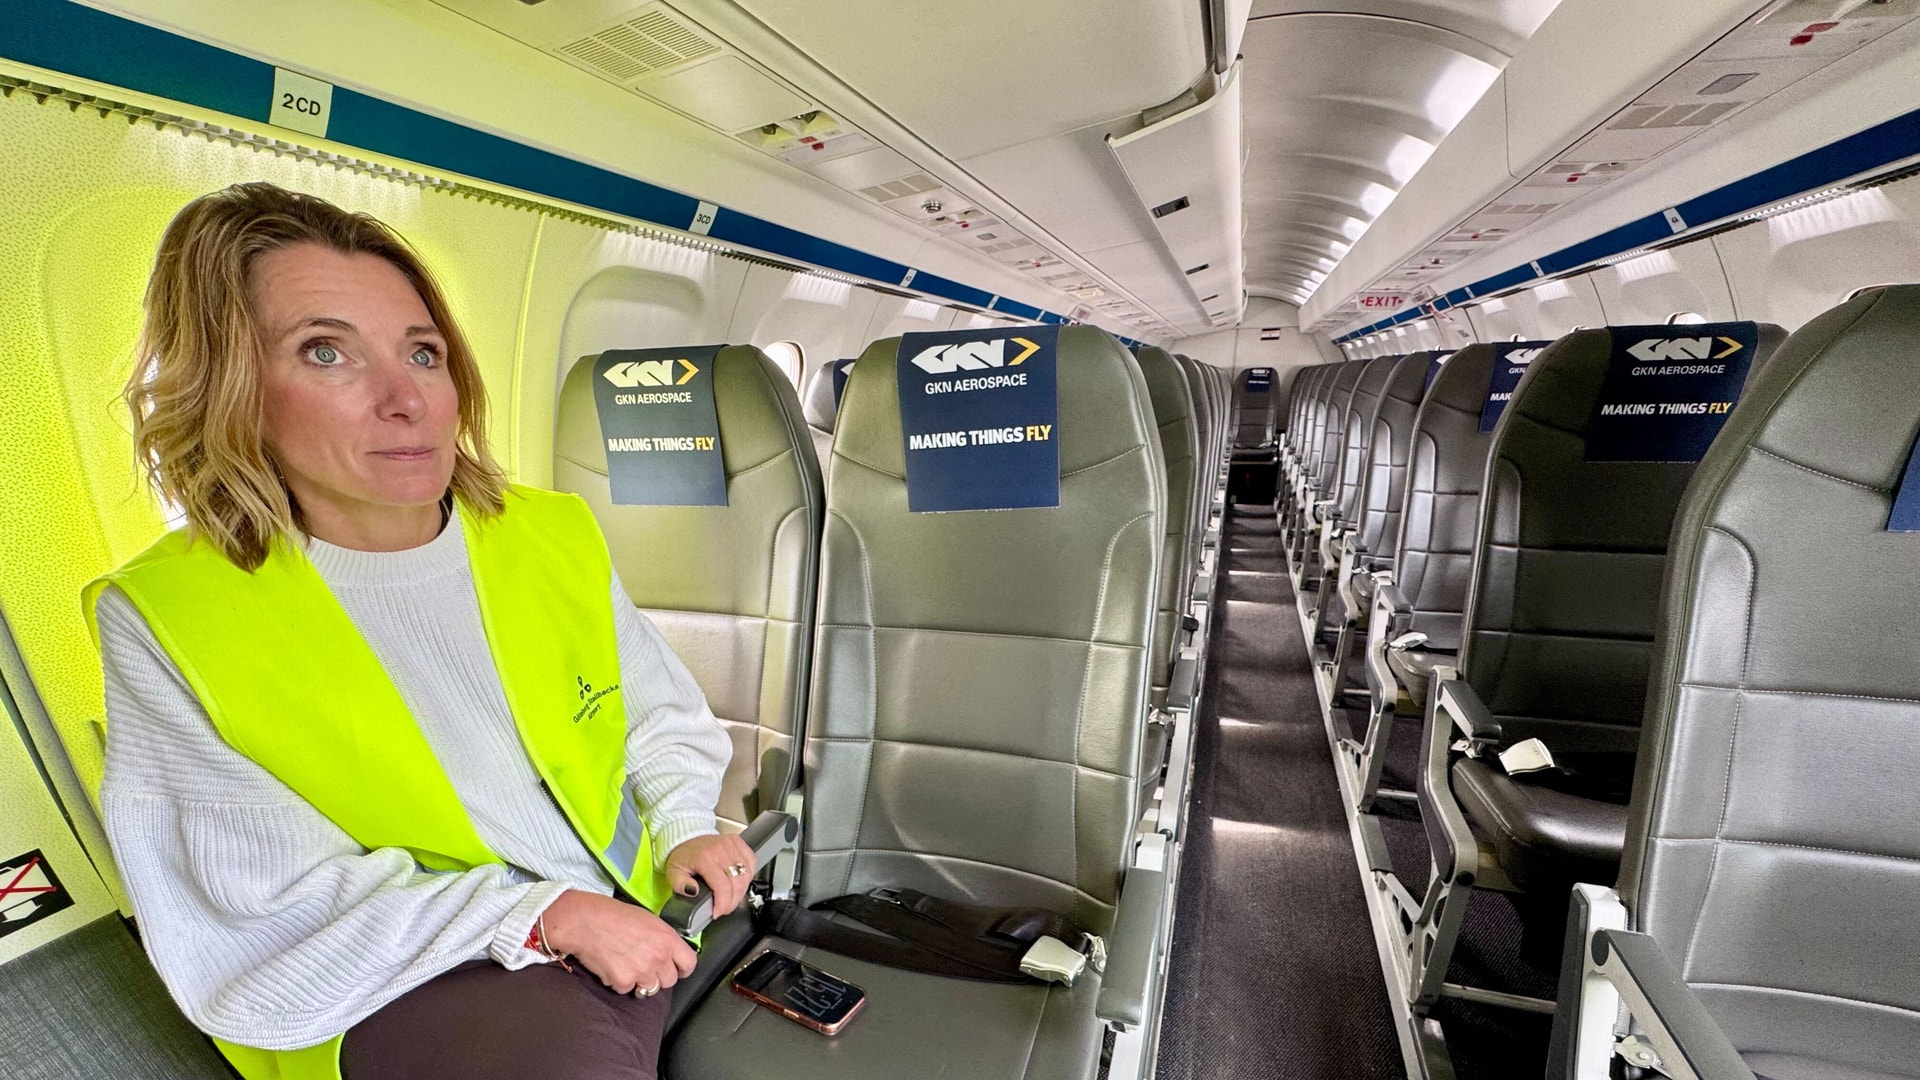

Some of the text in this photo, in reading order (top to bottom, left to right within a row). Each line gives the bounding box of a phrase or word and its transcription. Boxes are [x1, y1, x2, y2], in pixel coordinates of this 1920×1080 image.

[282, 93, 321, 116] 2CD
[696, 213, 711, 225] 3CD
[1365, 296, 1400, 307] EXIT
[1631, 365, 1725, 376] GKN AEROSPACE
[925, 373, 1028, 395] GKN AEROSPACE
[615, 392, 693, 405] GKN AEROSPACE
[1490, 392, 1512, 401] MAK
[1601, 402, 1732, 415] MAKING THINGS FLY
[608, 437, 715, 451] MAKING THINGS FLY
[909, 425, 1052, 450] MAKING THINGS FLY
[588, 684, 619, 705] Stallbacka
[588, 703, 602, 720] Airport
[784, 973, 847, 1017] 15:27
